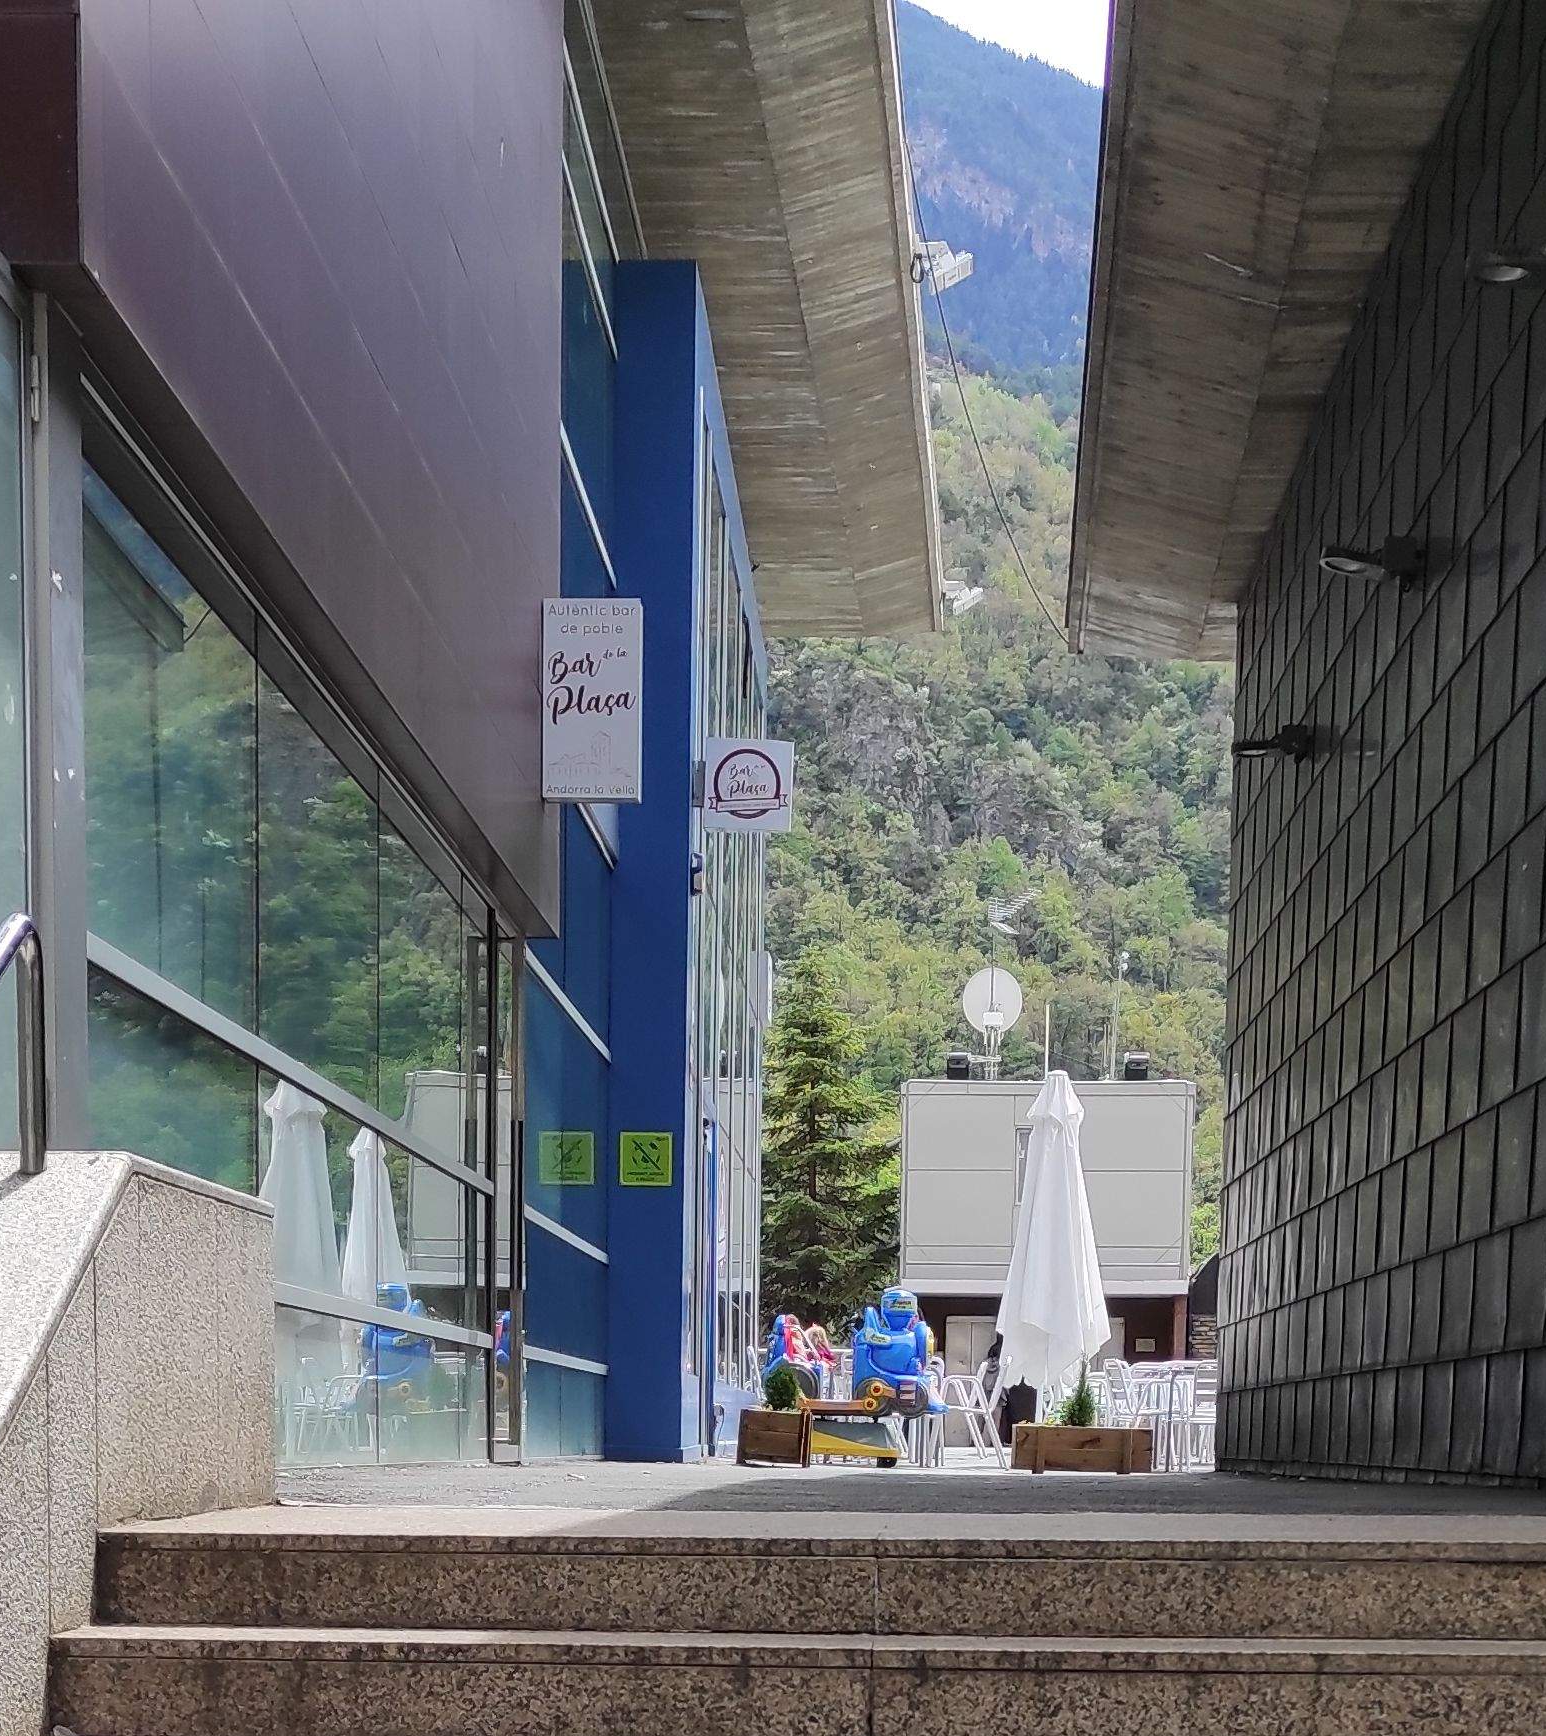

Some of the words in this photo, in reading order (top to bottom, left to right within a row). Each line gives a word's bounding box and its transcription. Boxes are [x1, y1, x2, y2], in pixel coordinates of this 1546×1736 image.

[611, 604, 636, 616] bar
[560, 622, 578, 634] de
[583, 621, 624, 636] poble
[548, 650, 602, 684] Bar
[546, 685, 637, 725] Plaça
[728, 763, 757, 780] Bar
[545, 784, 591, 796] Andorra
[594, 784, 605, 795] la
[728, 779, 770, 798] Plaça
